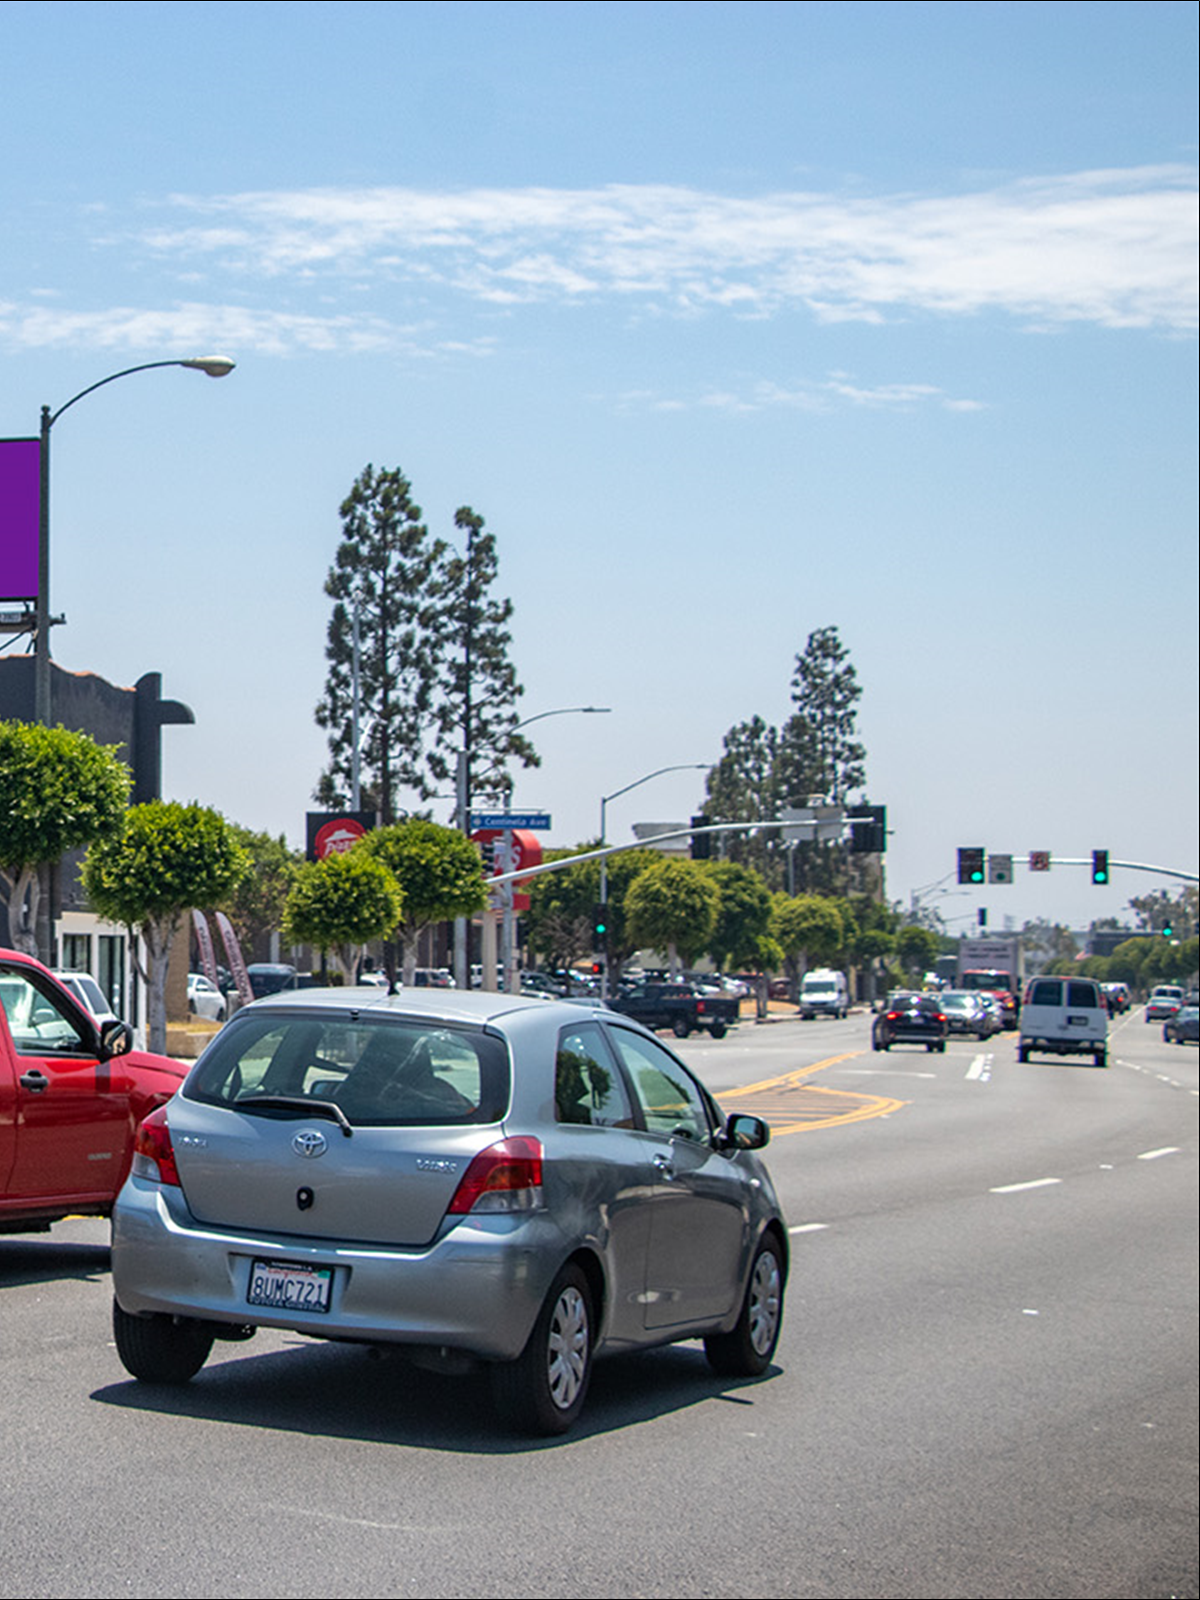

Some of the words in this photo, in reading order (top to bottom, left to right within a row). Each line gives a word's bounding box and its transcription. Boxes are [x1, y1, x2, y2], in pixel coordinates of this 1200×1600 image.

[484, 817, 527, 826] Centinela
[529, 818, 547, 826] Ave
[253, 1276, 324, 1304] 8UMC721
